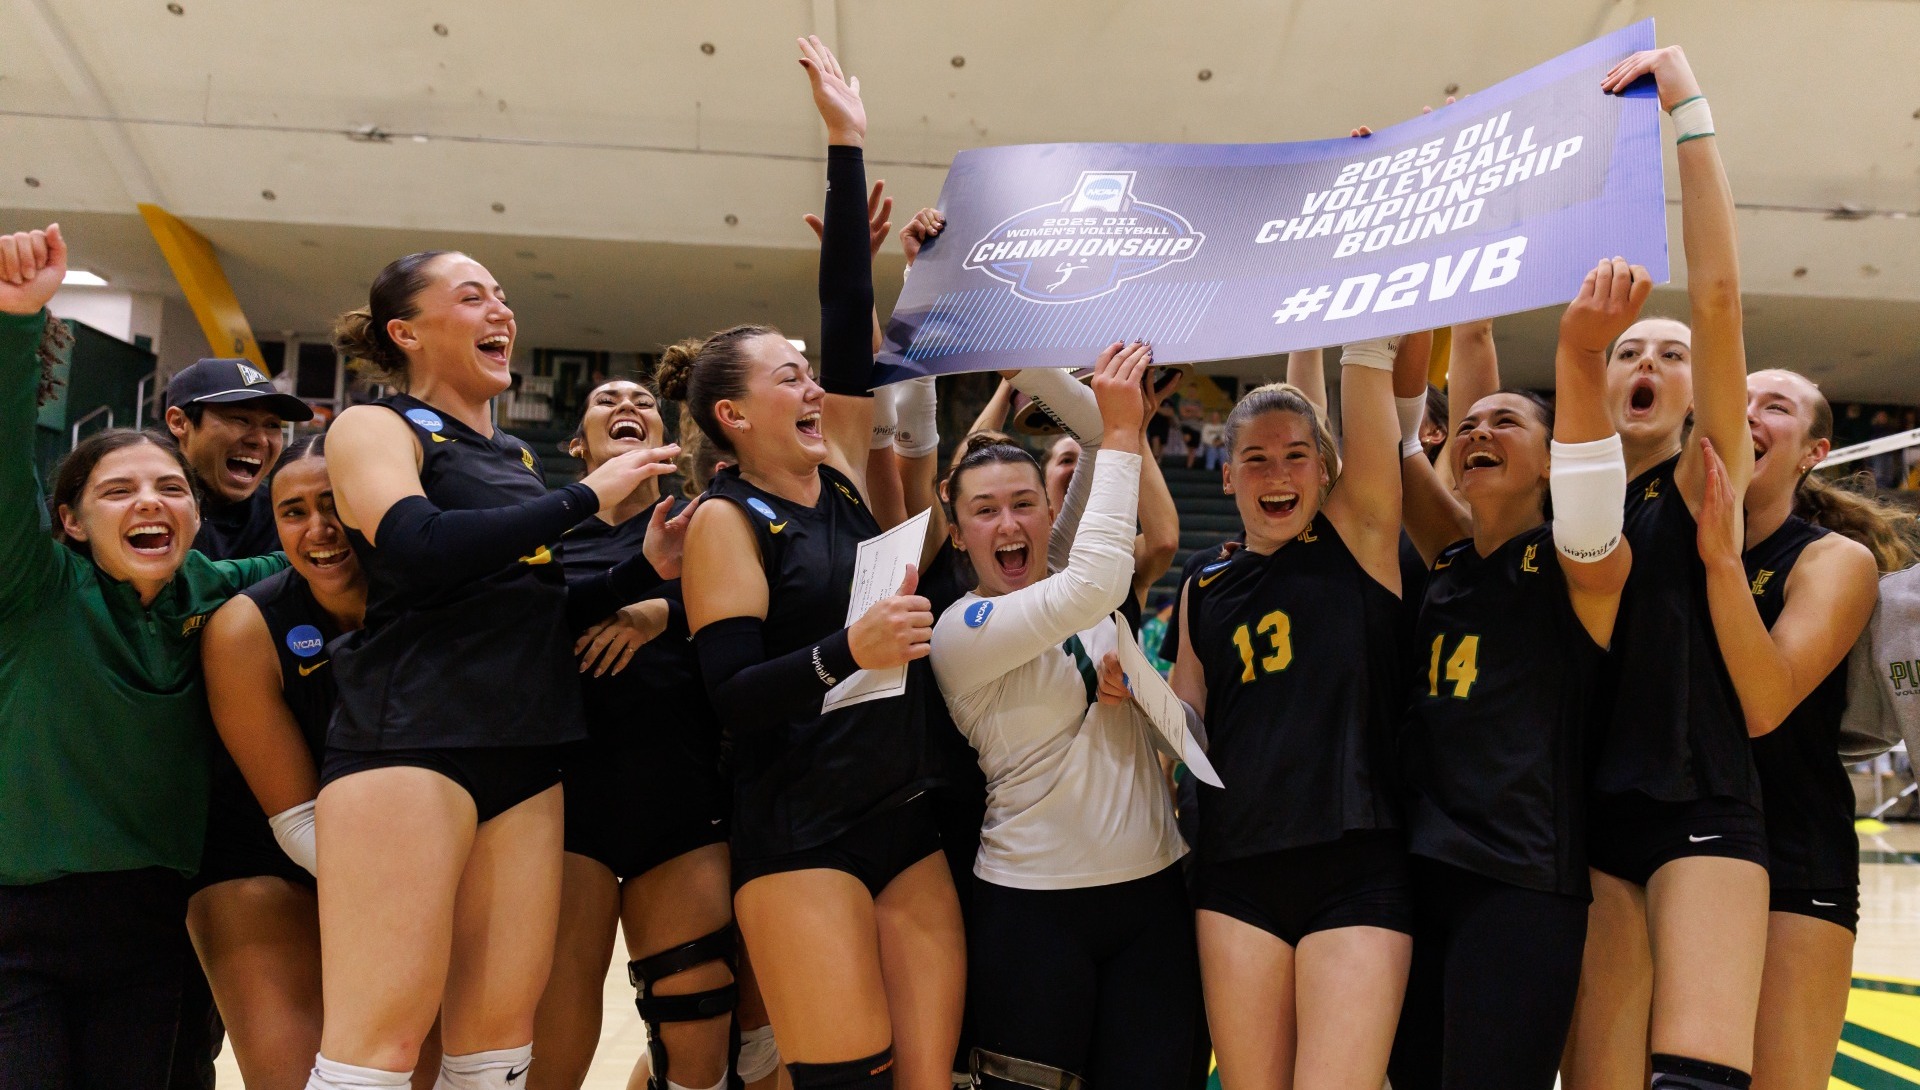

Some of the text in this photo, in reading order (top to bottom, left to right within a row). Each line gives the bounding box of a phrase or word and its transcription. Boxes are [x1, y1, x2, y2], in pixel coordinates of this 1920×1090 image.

[1301, 126, 1537, 214] VOLLEYBALL
[1334, 110, 1512, 187] 2025 DII
[1255, 135, 1583, 243] CHAMPIONSHIP
[973, 238, 1194, 263] CHAMPIONSHIP
[1007, 227, 1170, 238] WOMEN'S VOLLEYBALL
[1043, 217, 1138, 226] 2025 DII
[1333, 198, 1484, 258] BOUND
[1272, 235, 1528, 324] #D2VB
[413, 418, 442, 427] NCAA
[974, 601, 990, 623] NCAA
[293, 638, 322, 650] NCAA
[1232, 609, 1293, 684] 13
[1428, 632, 1481, 699] 14
